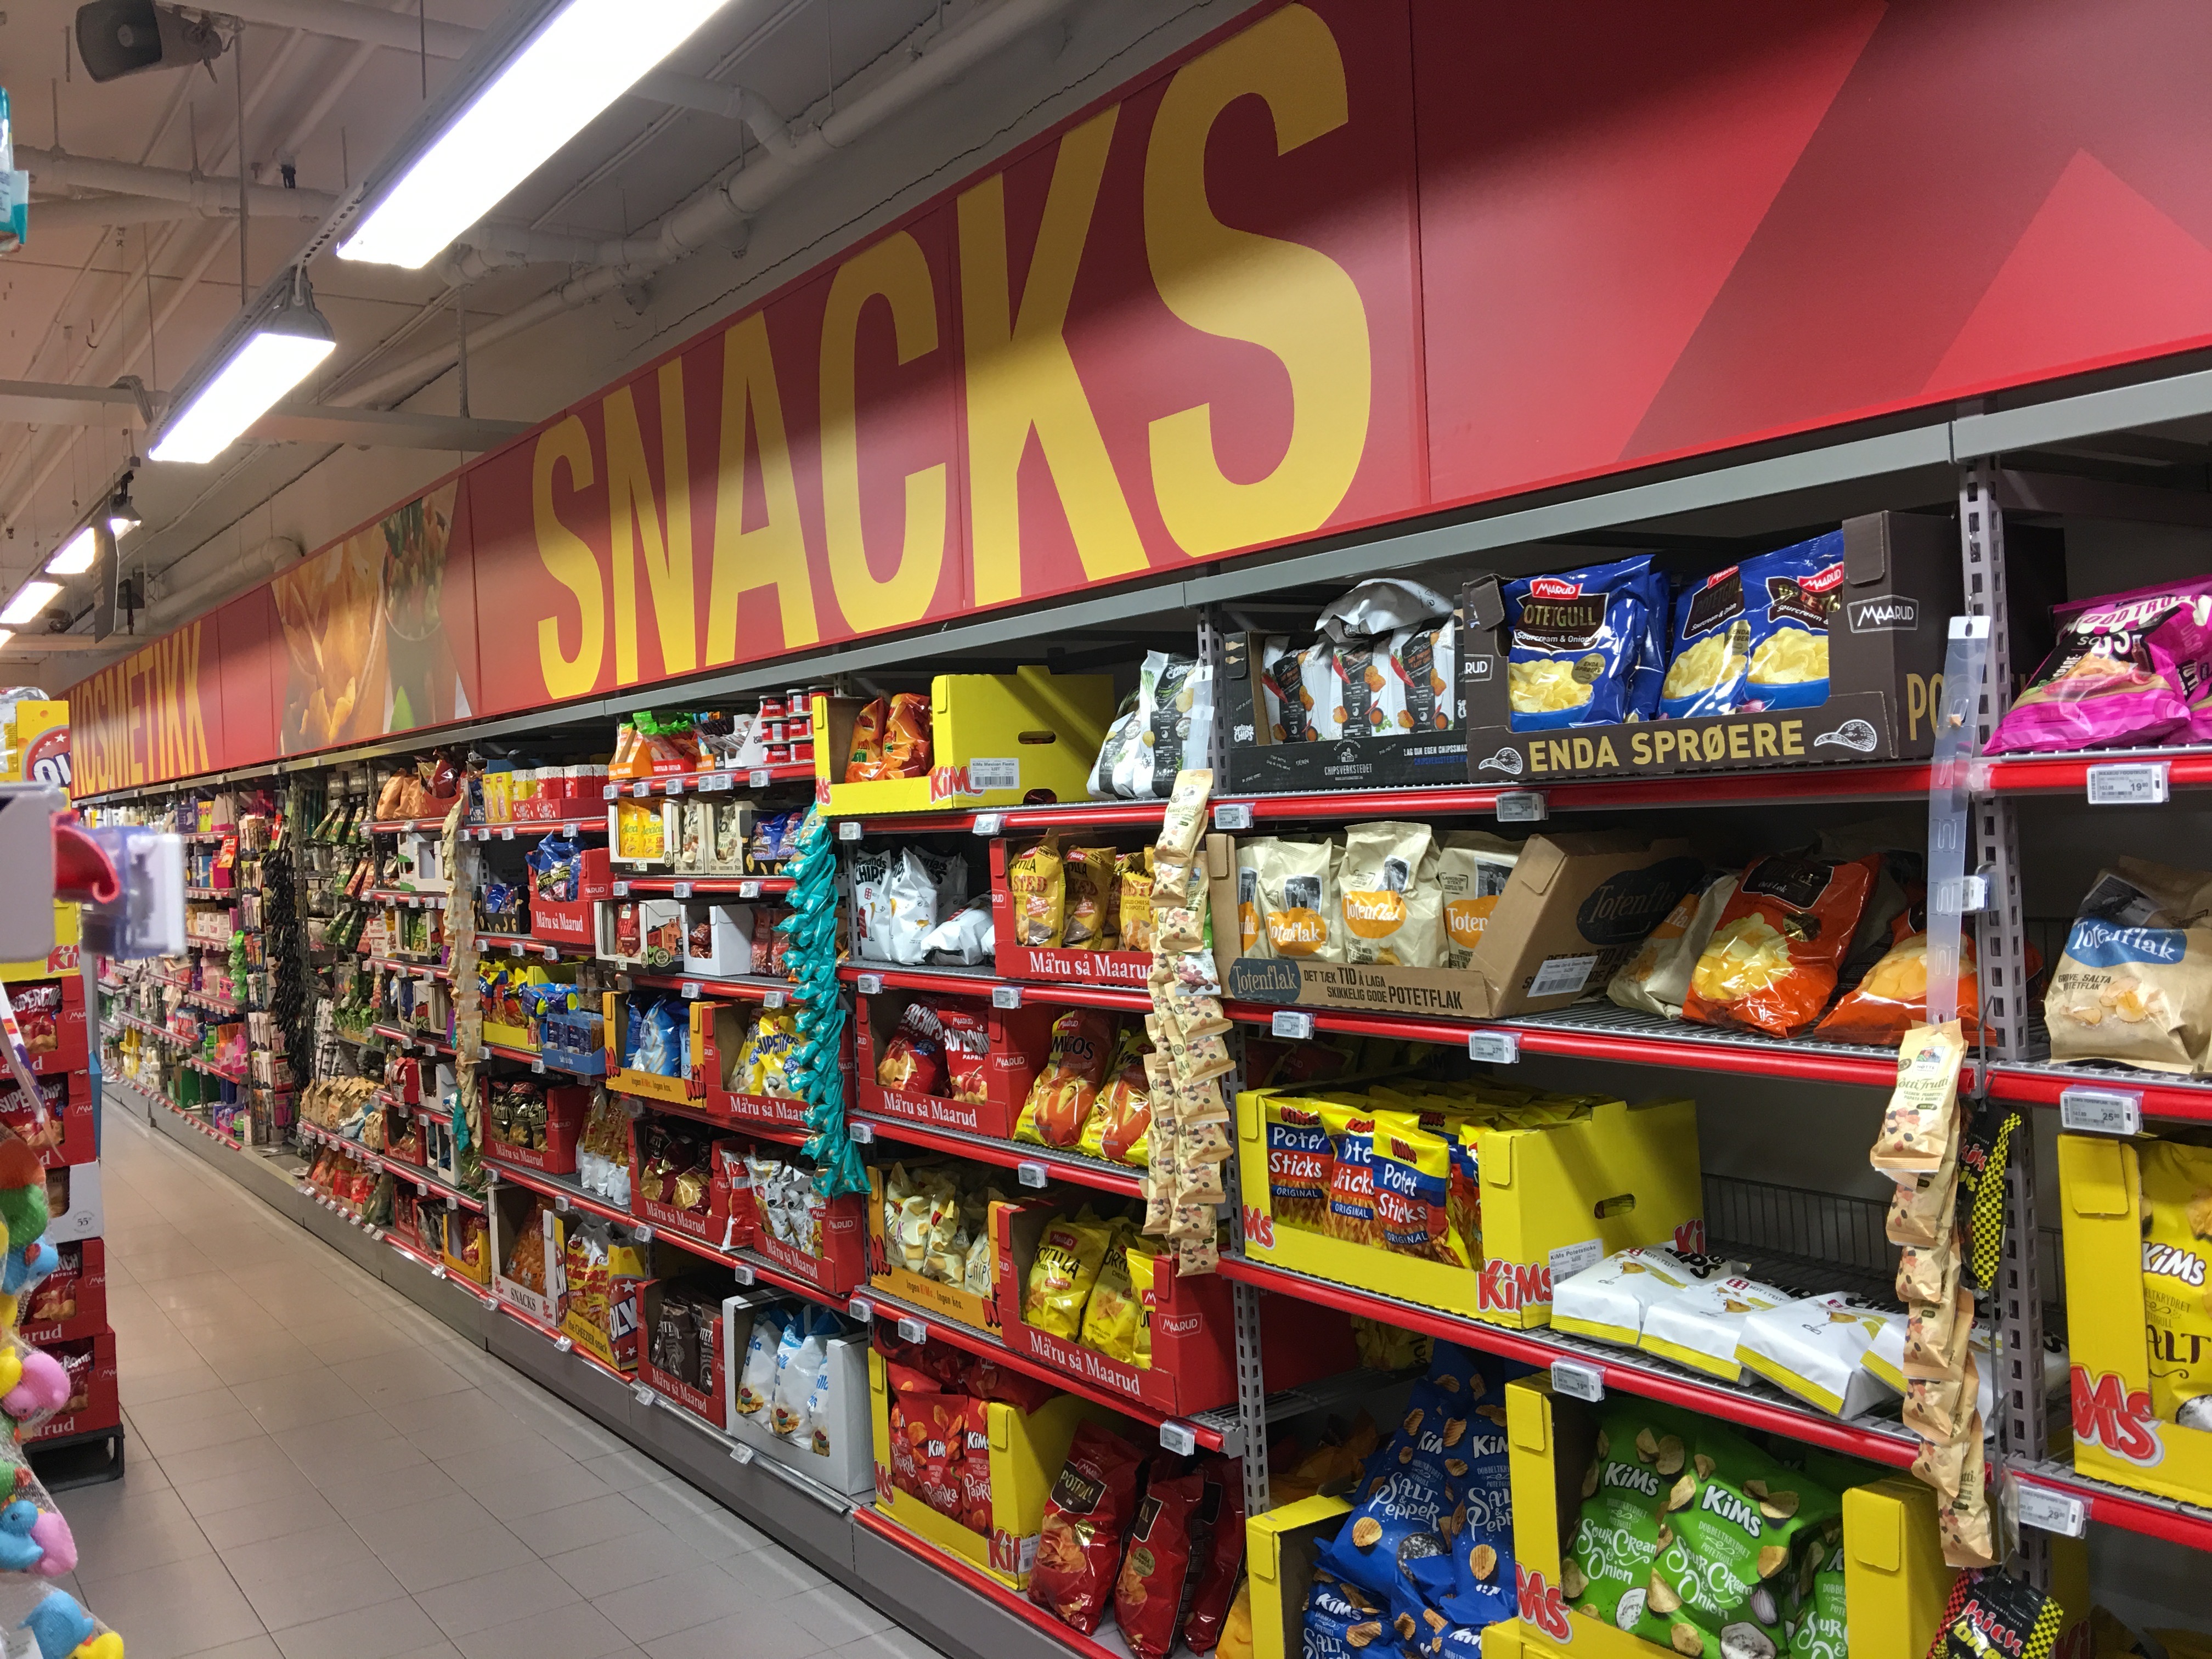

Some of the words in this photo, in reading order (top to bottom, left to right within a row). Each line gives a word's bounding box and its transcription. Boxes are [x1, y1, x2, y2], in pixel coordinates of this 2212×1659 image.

[532, 2, 1372, 701] SNACKS
[1537, 582, 1575, 595] MAARUD
[1805, 568, 1842, 591] MAARUD
[1858, 606, 1914, 627] MAARUD
[70, 620, 210, 797] KOSMETIKK
[1234, 730, 1255, 743] CHIPS
[1528, 736, 1619, 772] ENDA
[1630, 720, 1805, 765] SPRØERE
[1324, 764, 1373, 776] CHIPSVERKSTEDET
[855, 865, 885, 885] CHIPS
[559, 915, 583, 932] Maarud
[2073, 921, 2176, 961] Totenflak
[1074, 958, 1091, 975] så
[1304, 969, 1318, 982] DET
[1319, 971, 1336, 984] TÆK
[1336, 967, 1357, 986] TID
[1365, 975, 1386, 988] LAGA
[1233, 964, 1298, 994] Totenflak
[2082, 974, 2112, 984] SALTA
[1327, 986, 1365, 1002] SKIKKELIG
[1367, 989, 1387, 1003] GODE
[1389, 986, 1464, 1010] POTETFLAK
[995, 1057, 1025, 1067] MAARUD
[761, 1101, 774, 1118] så
[916, 1098, 930, 1117] så
[931, 1104, 978, 1128] Maarud
[1280, 1105, 1321, 1125] KiMs
[520, 1148, 544, 1167] Maarud
[1390, 1137, 1418, 1164] KiMs
[1269, 1152, 1323, 1178] Sticks
[1276, 1187, 1318, 1198] ORIGINAL
[1384, 1164, 1417, 1197] Potet
[1334, 1203, 1369, 1218] ORIGINAL
[1378, 1193, 1426, 1223] Sticks
[667, 1208, 676, 1221] så
[676, 1211, 706, 1235] Maarud
[1387, 1231, 1428, 1245] ORIGINAL
[52, 1270, 78, 1278] PAPRIKA
[784, 1248, 792, 1263] så
[791, 1250, 818, 1279] Maarud
[2142, 1244, 2205, 1284] KiMs
[906, 1279, 920, 1294] Ingen
[936, 1290, 951, 1305] Ingen
[1479, 1260, 1551, 1311] KiMs
[510, 1288, 537, 1312] SNACKS
[1163, 1318, 1198, 1333] MAARUD
[1068, 1347, 1084, 1373] så
[1085, 1352, 1141, 1397] Maarud
[680, 1381, 707, 1414] Maarud
[928, 1440, 947, 1458] KiMs
[1605, 1463, 1660, 1497] KiMs
[1399, 1495, 1407, 1505] &
[1495, 1508, 1503, 1517] &
[1702, 1486, 1763, 1539] KiMs
[1699, 1521, 1751, 1559] DOBBELTKRYDRET
[1606, 1548, 1614, 1559] &
[1701, 1541, 1734, 1567] POTETGULL
[1587, 1550, 1633, 1584] Onion
[1315, 1593, 1362, 1621] KiMs
[1678, 1570, 1729, 1621] Onion
